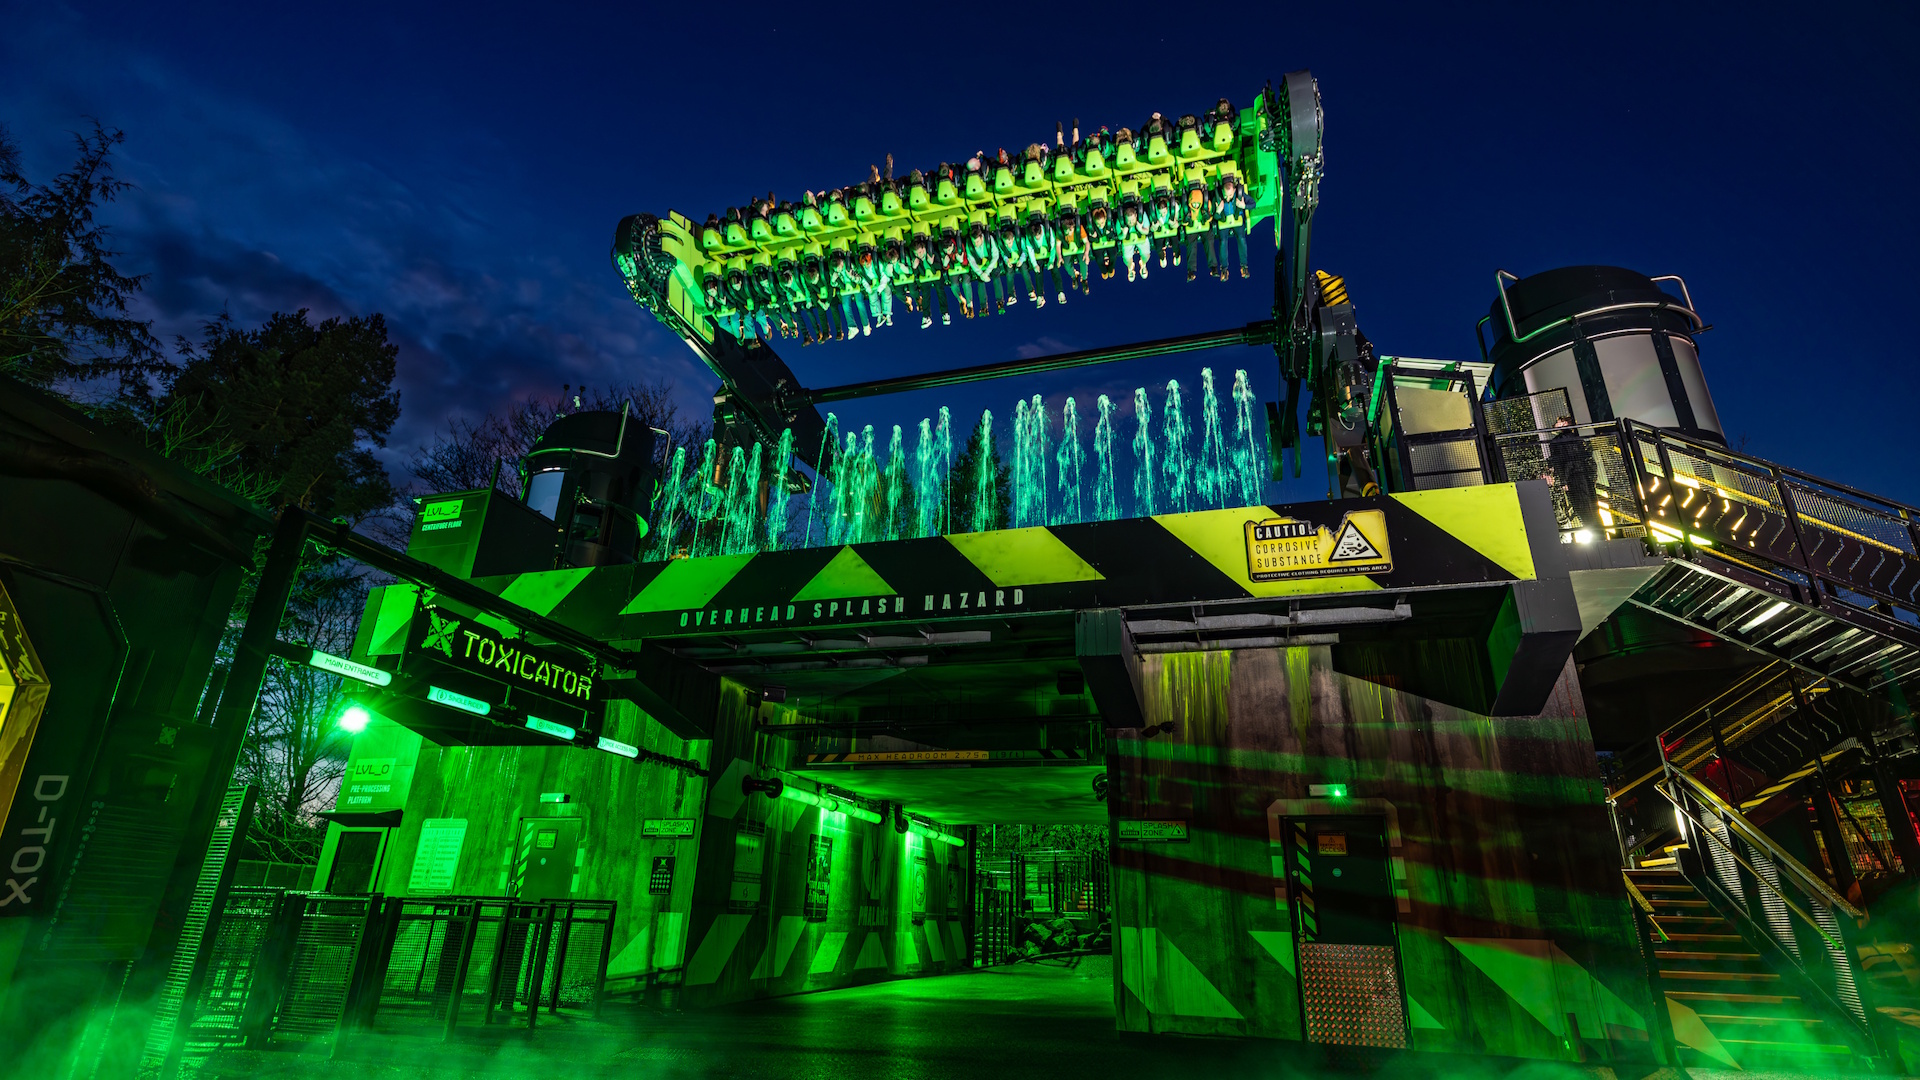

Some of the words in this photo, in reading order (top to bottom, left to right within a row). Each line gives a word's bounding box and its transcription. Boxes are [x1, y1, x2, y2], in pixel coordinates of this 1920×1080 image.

[427, 505, 459, 516] LVL_2
[1256, 524, 1316, 540] CAUTIO
[1256, 540, 1319, 554] CORROSIVE
[1257, 554, 1322, 568] SUBSTANCE
[1256, 571, 1290, 579] PROTECTIVE
[680, 605, 796, 627] OVERHEAD
[813, 597, 905, 619] SPLASH
[924, 588, 1024, 611] HAZARD
[325, 657, 344, 669] MAIN
[344, 663, 380, 680] ENTRANCE
[463, 630, 592, 700] TOXICATOR
[448, 694, 467, 706] SINGLE
[886, 752, 948, 760] HEADROOM
[356, 764, 390, 776] LVL_0
[350, 784, 391, 793] PRE-PROCESSING
[347, 796, 373, 804] PLATFORM
[663, 821, 685, 829] SPLASH
[1142, 822, 1173, 830] SPLASH
[0, 775, 69, 907] D-TOX
